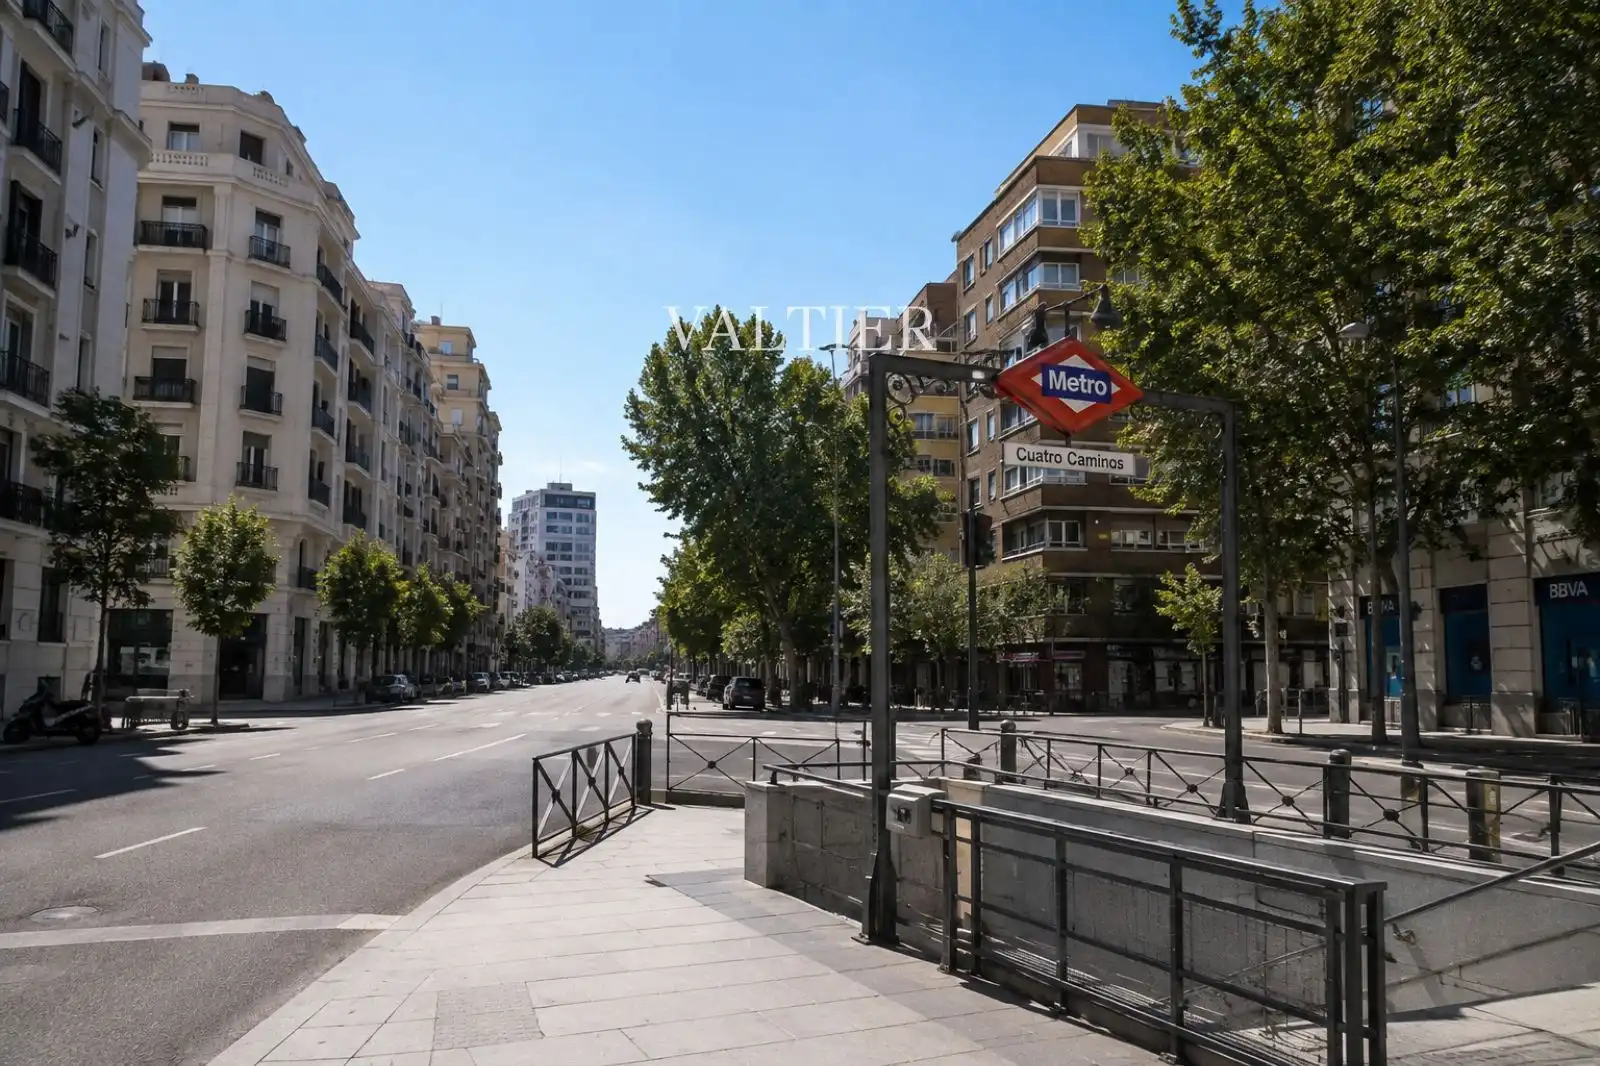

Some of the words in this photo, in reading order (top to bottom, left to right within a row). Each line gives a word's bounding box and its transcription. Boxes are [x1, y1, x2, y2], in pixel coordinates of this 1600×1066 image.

[1048, 369, 1108, 396] Metro
[1016, 447, 1063, 464] Cuatro
[1067, 451, 1124, 470] Caminos
[1549, 580, 1589, 599] BBVA
